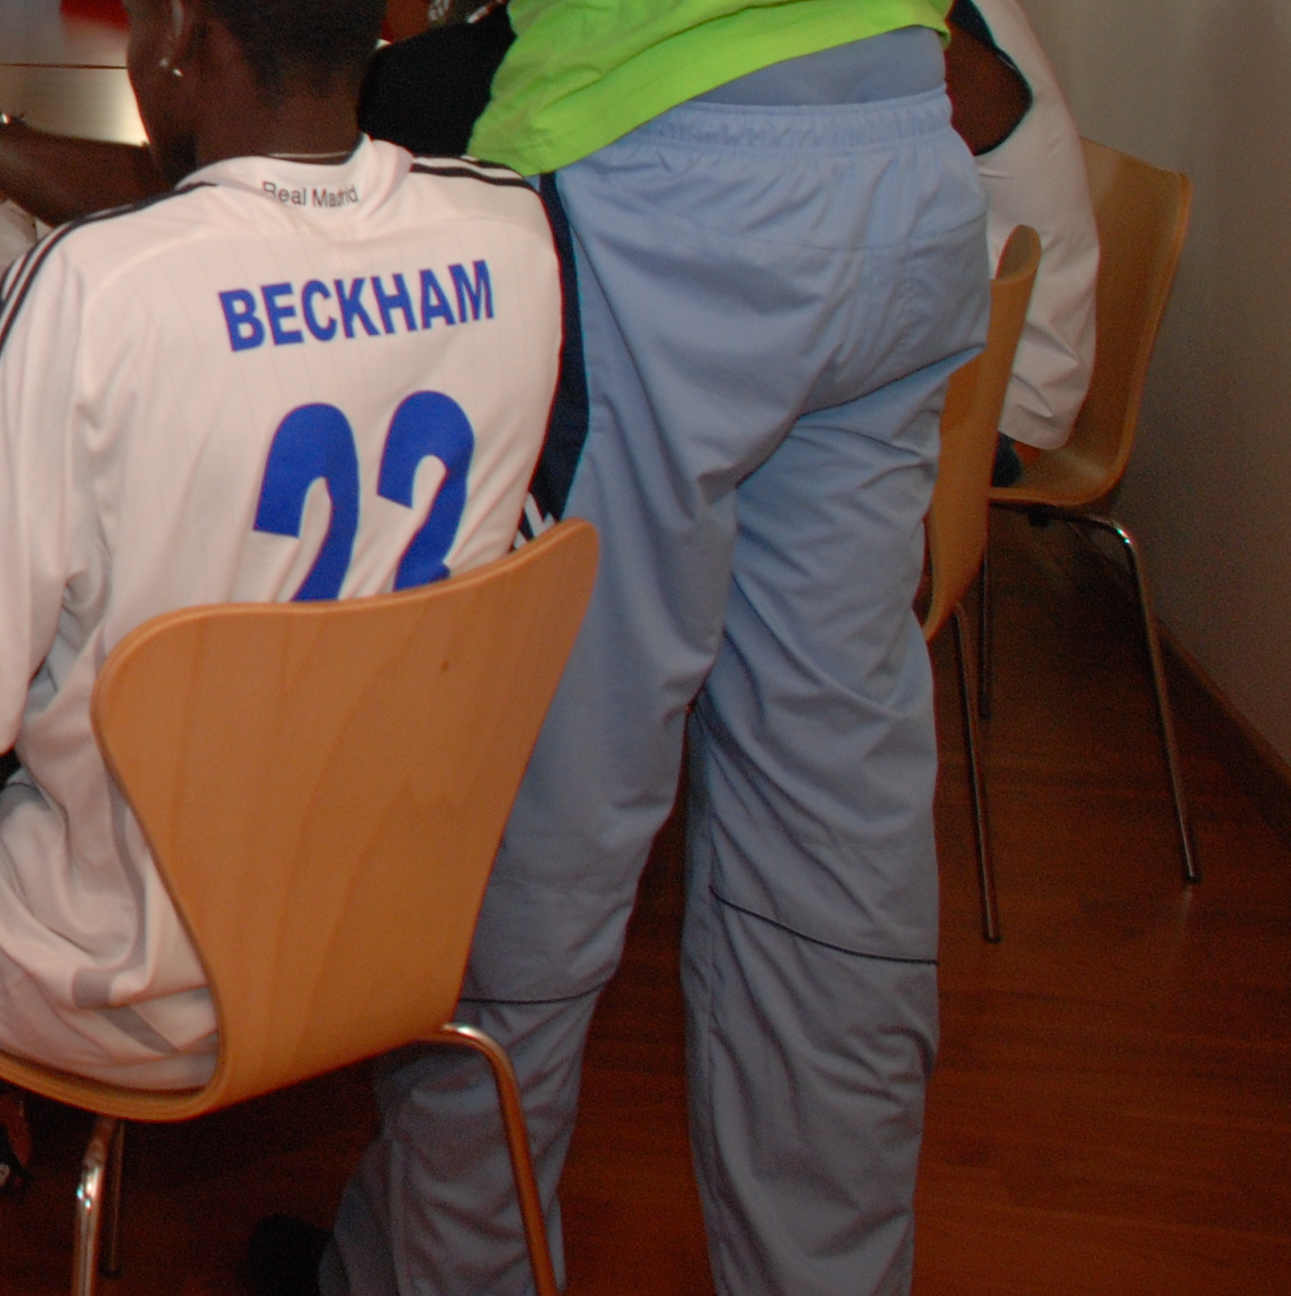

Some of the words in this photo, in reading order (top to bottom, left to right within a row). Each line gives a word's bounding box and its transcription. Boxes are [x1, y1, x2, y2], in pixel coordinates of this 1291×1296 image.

[262, 180, 307, 207] Real
[218, 259, 494, 352] BECKHAM
[253, 390, 476, 603] 22
